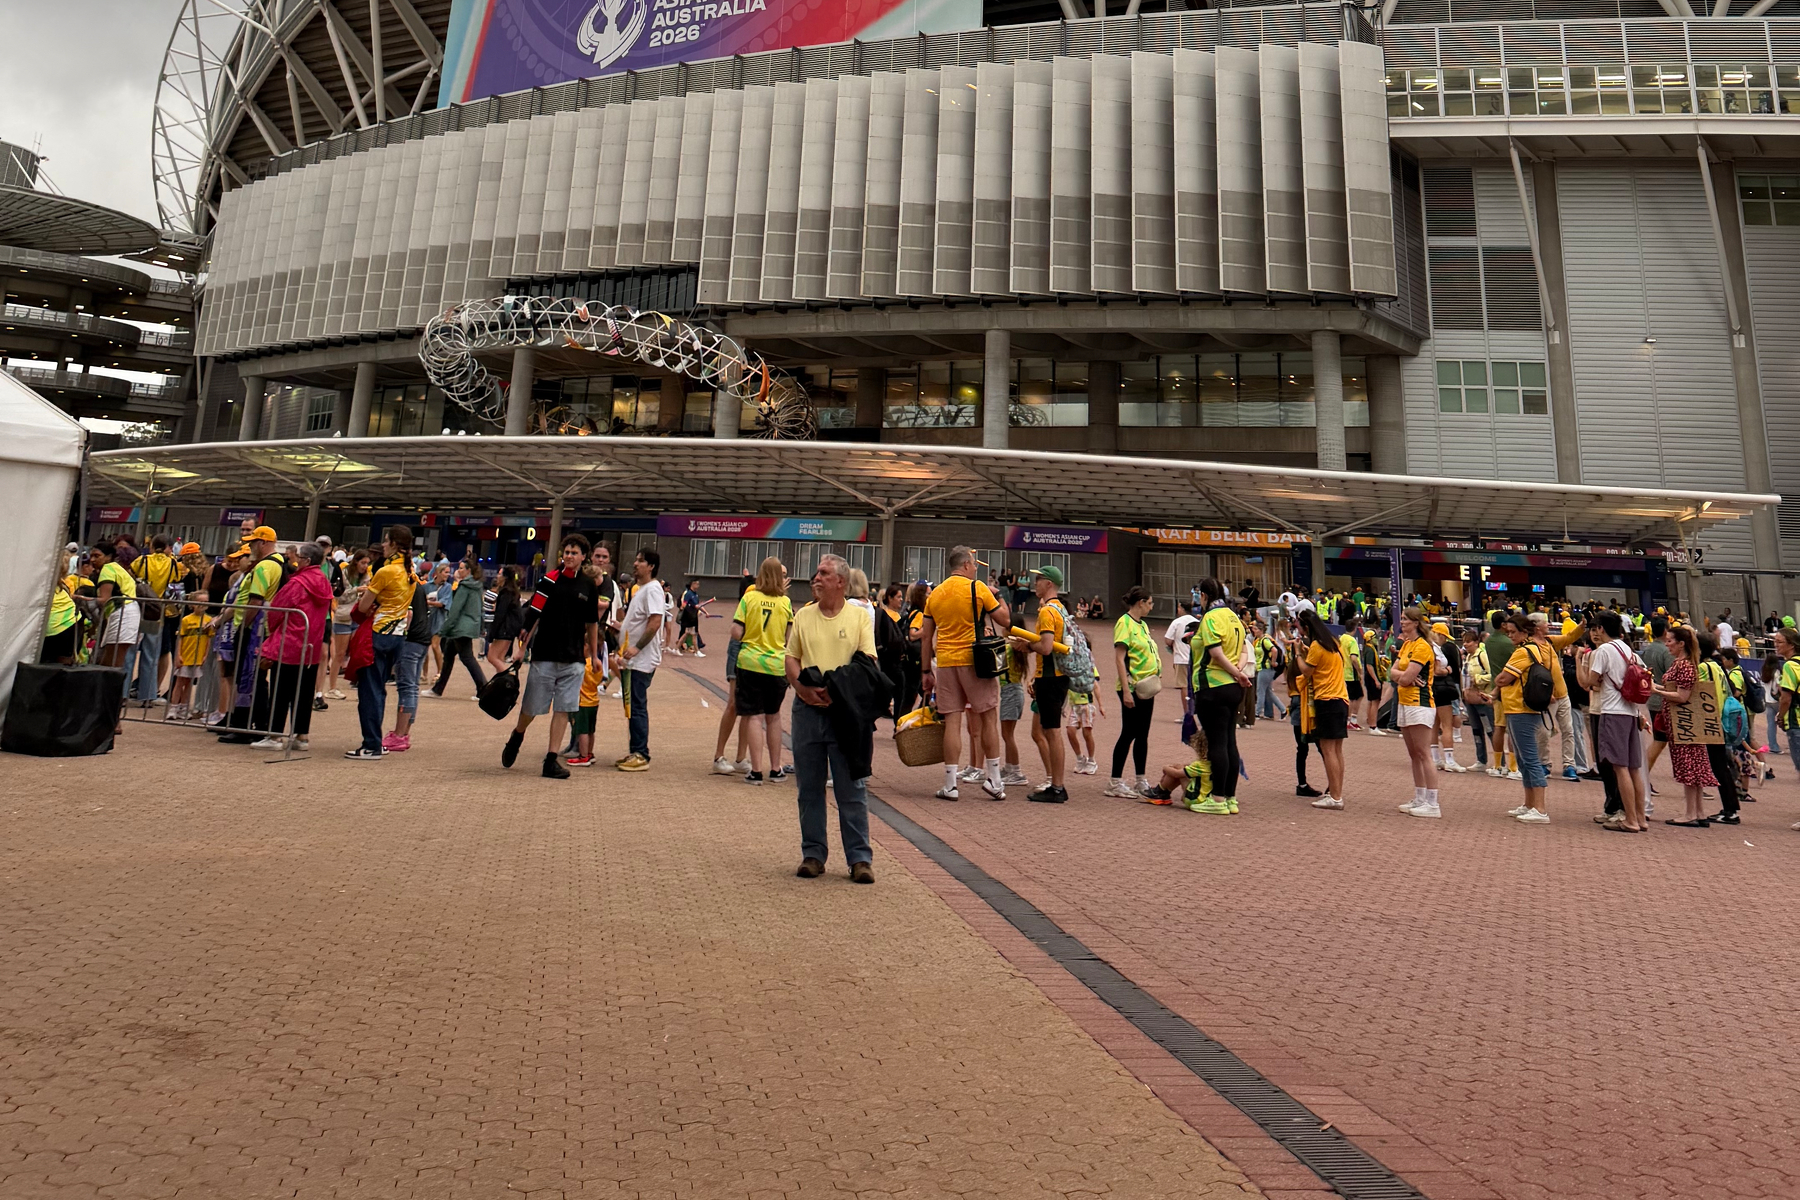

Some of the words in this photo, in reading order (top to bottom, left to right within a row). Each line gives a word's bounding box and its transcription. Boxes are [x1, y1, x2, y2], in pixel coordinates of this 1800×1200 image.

[421, 515, 427, 525] C
[527, 527, 536, 541] D
[1455, 554, 1498, 562] WELCOME
[1460, 565, 1470, 580] E
[1481, 566, 1491, 581] F
[762, 608, 772, 632] 7
[1700, 691, 1715, 713] GO
[1704, 717, 1721, 737] THE
